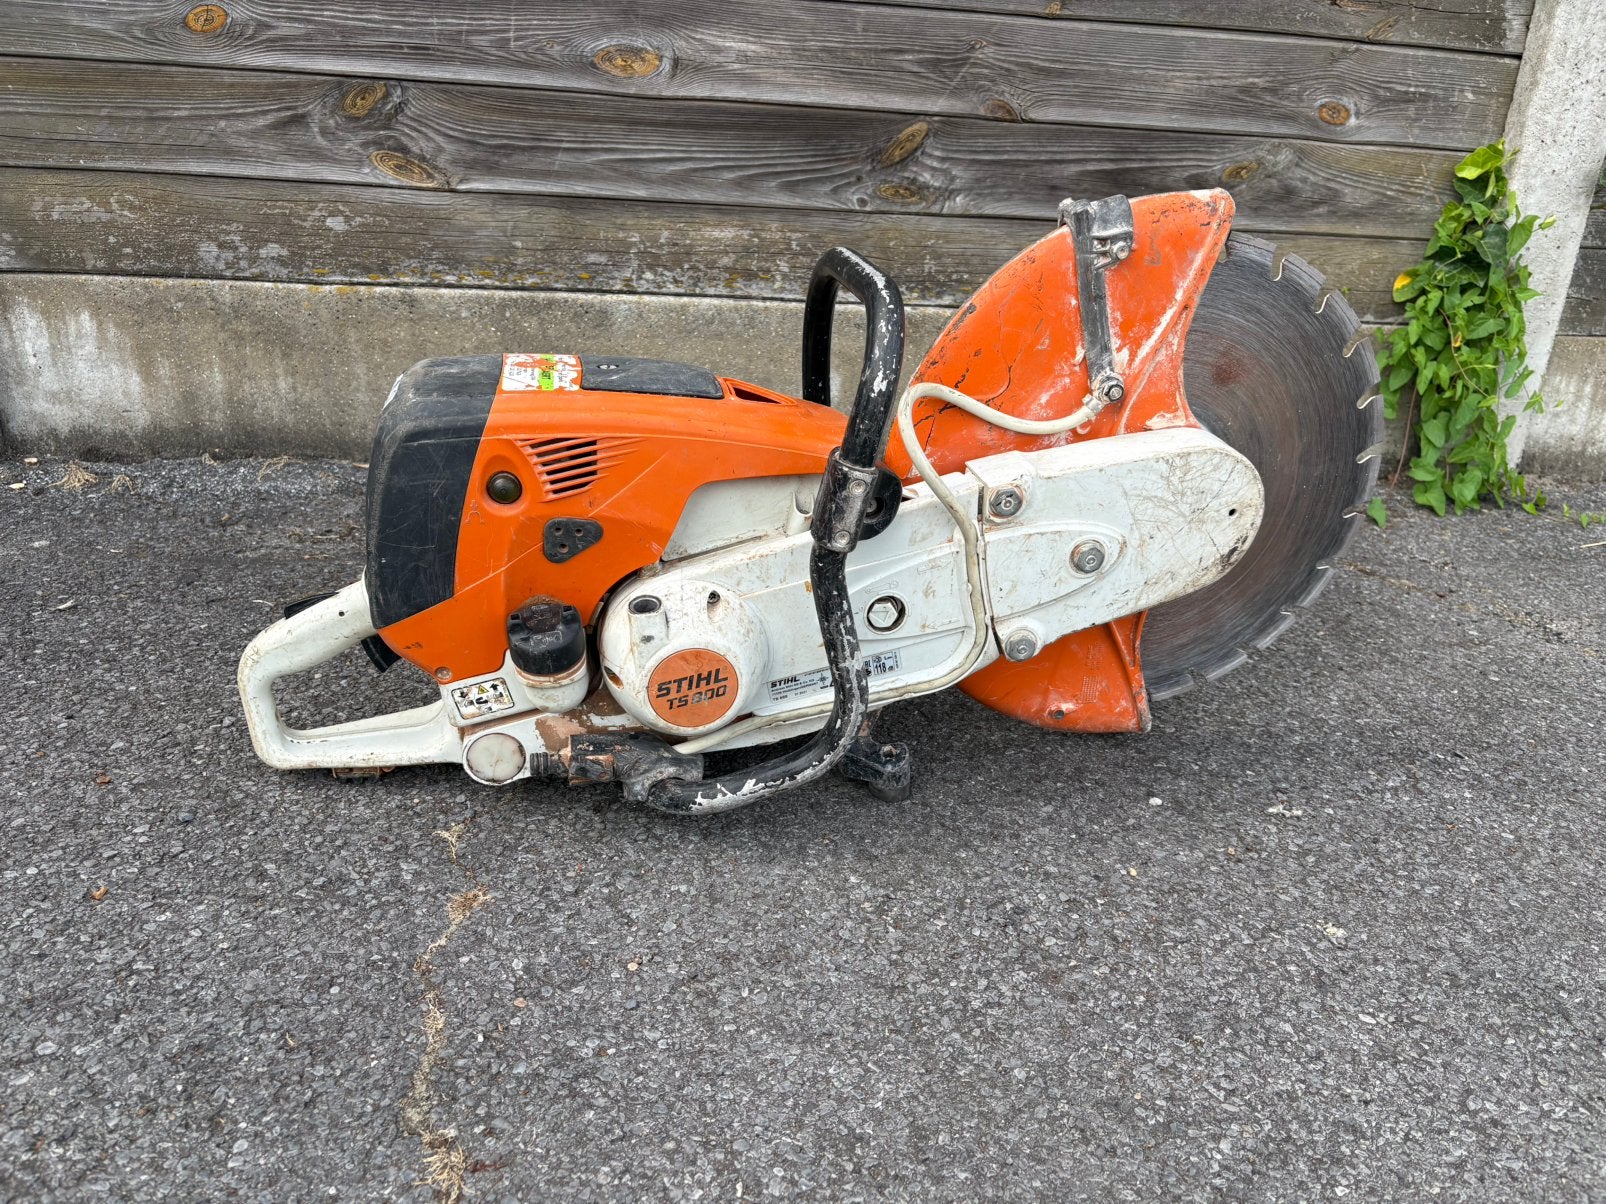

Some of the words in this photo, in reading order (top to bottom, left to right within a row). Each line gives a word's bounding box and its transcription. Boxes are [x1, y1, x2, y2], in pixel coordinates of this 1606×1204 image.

[874, 662, 887, 674] 118
[656, 668, 729, 699] STIHL
[770, 675, 801, 689] STIHL
[666, 695, 689, 710] TS
[691, 684, 728, 705] 800
